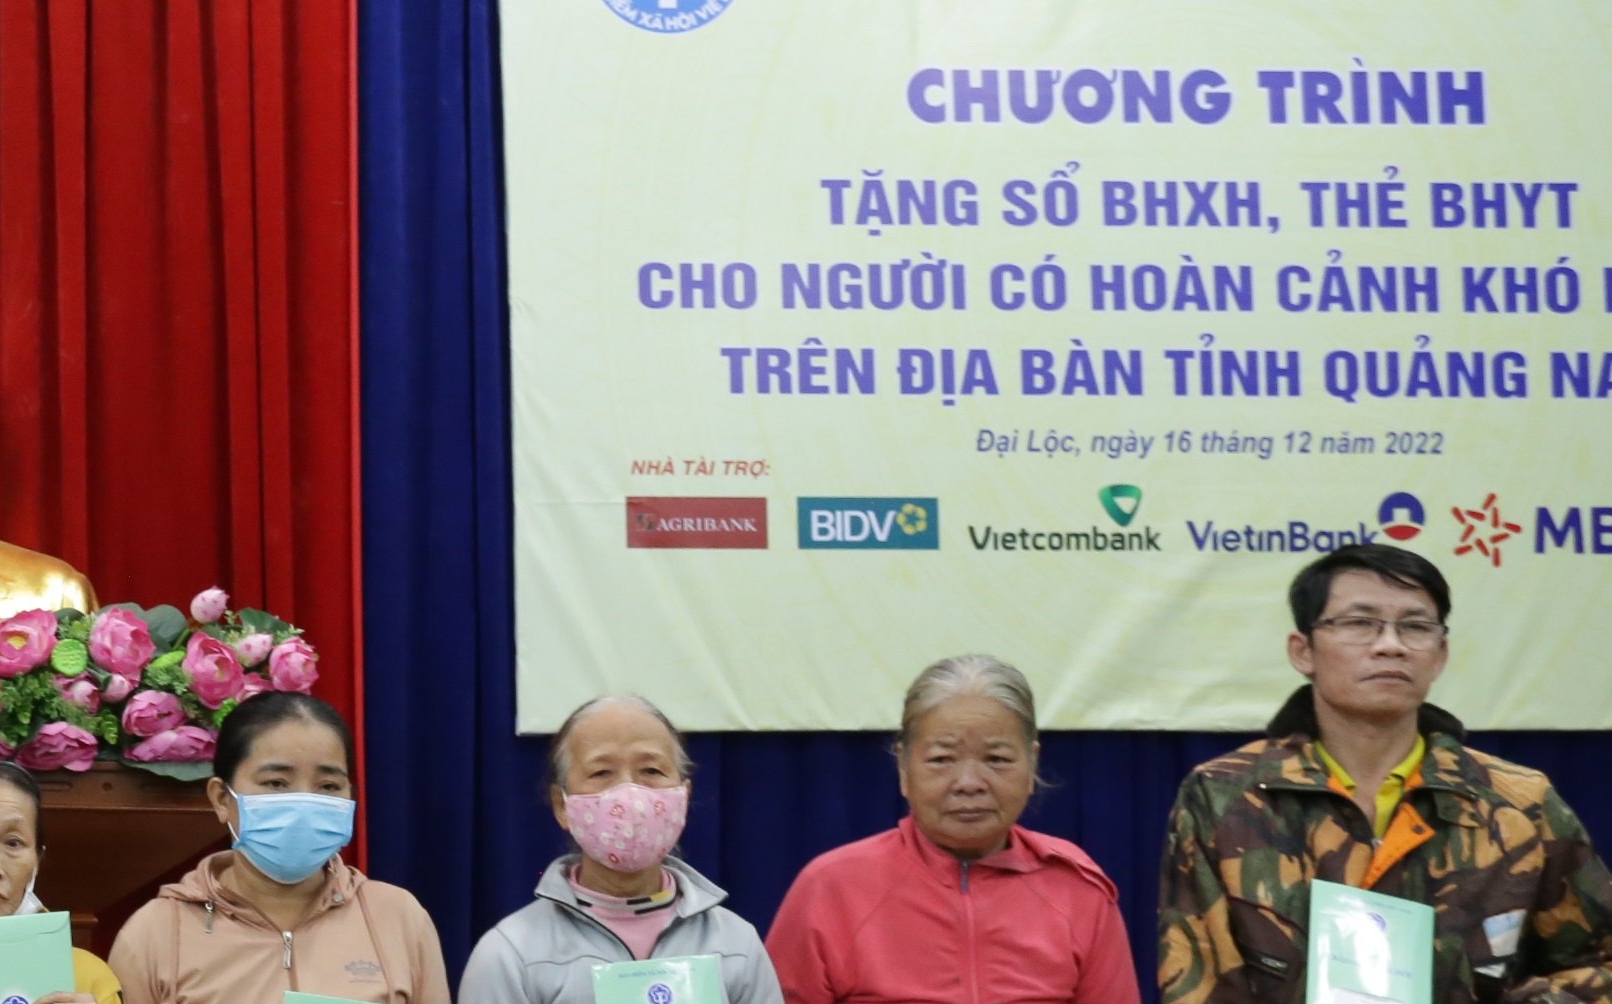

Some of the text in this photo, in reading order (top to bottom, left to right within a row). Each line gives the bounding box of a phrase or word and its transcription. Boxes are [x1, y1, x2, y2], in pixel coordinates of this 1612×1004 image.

[906, 57, 1487, 126] CHƯƠNG TRÌNH
[820, 161, 1581, 237] TẶNG SỔ BHXH, THẺ BHYT
[637, 261, 758, 311] CHO
[780, 252, 968, 312] NGƯỜI
[989, 254, 1069, 313] CÓ
[1090, 254, 1256, 313] HOÀN
[1276, 249, 1442, 314] CẢNH
[1461, 256, 1583, 315] KHÓ
[719, 336, 878, 396] TRÊN
[895, 347, 1001, 408] ĐỊA
[1019, 338, 1146, 397] BÀN
[1163, 333, 1304, 398] TỈNH
[1323, 334, 1531, 405] QUẢNG
[975, 429, 1445, 460] Đại Lộc, ngày 16 tháng 12 năm 2022
[630, 456, 771, 480] NHÀ TÀI TRỢ:
[656, 517, 758, 532] AGRIBANK
[810, 509, 897, 542] BIDV
[967, 524, 1162, 553] Vietcombank
[1185, 520, 1379, 553] VietinBank
